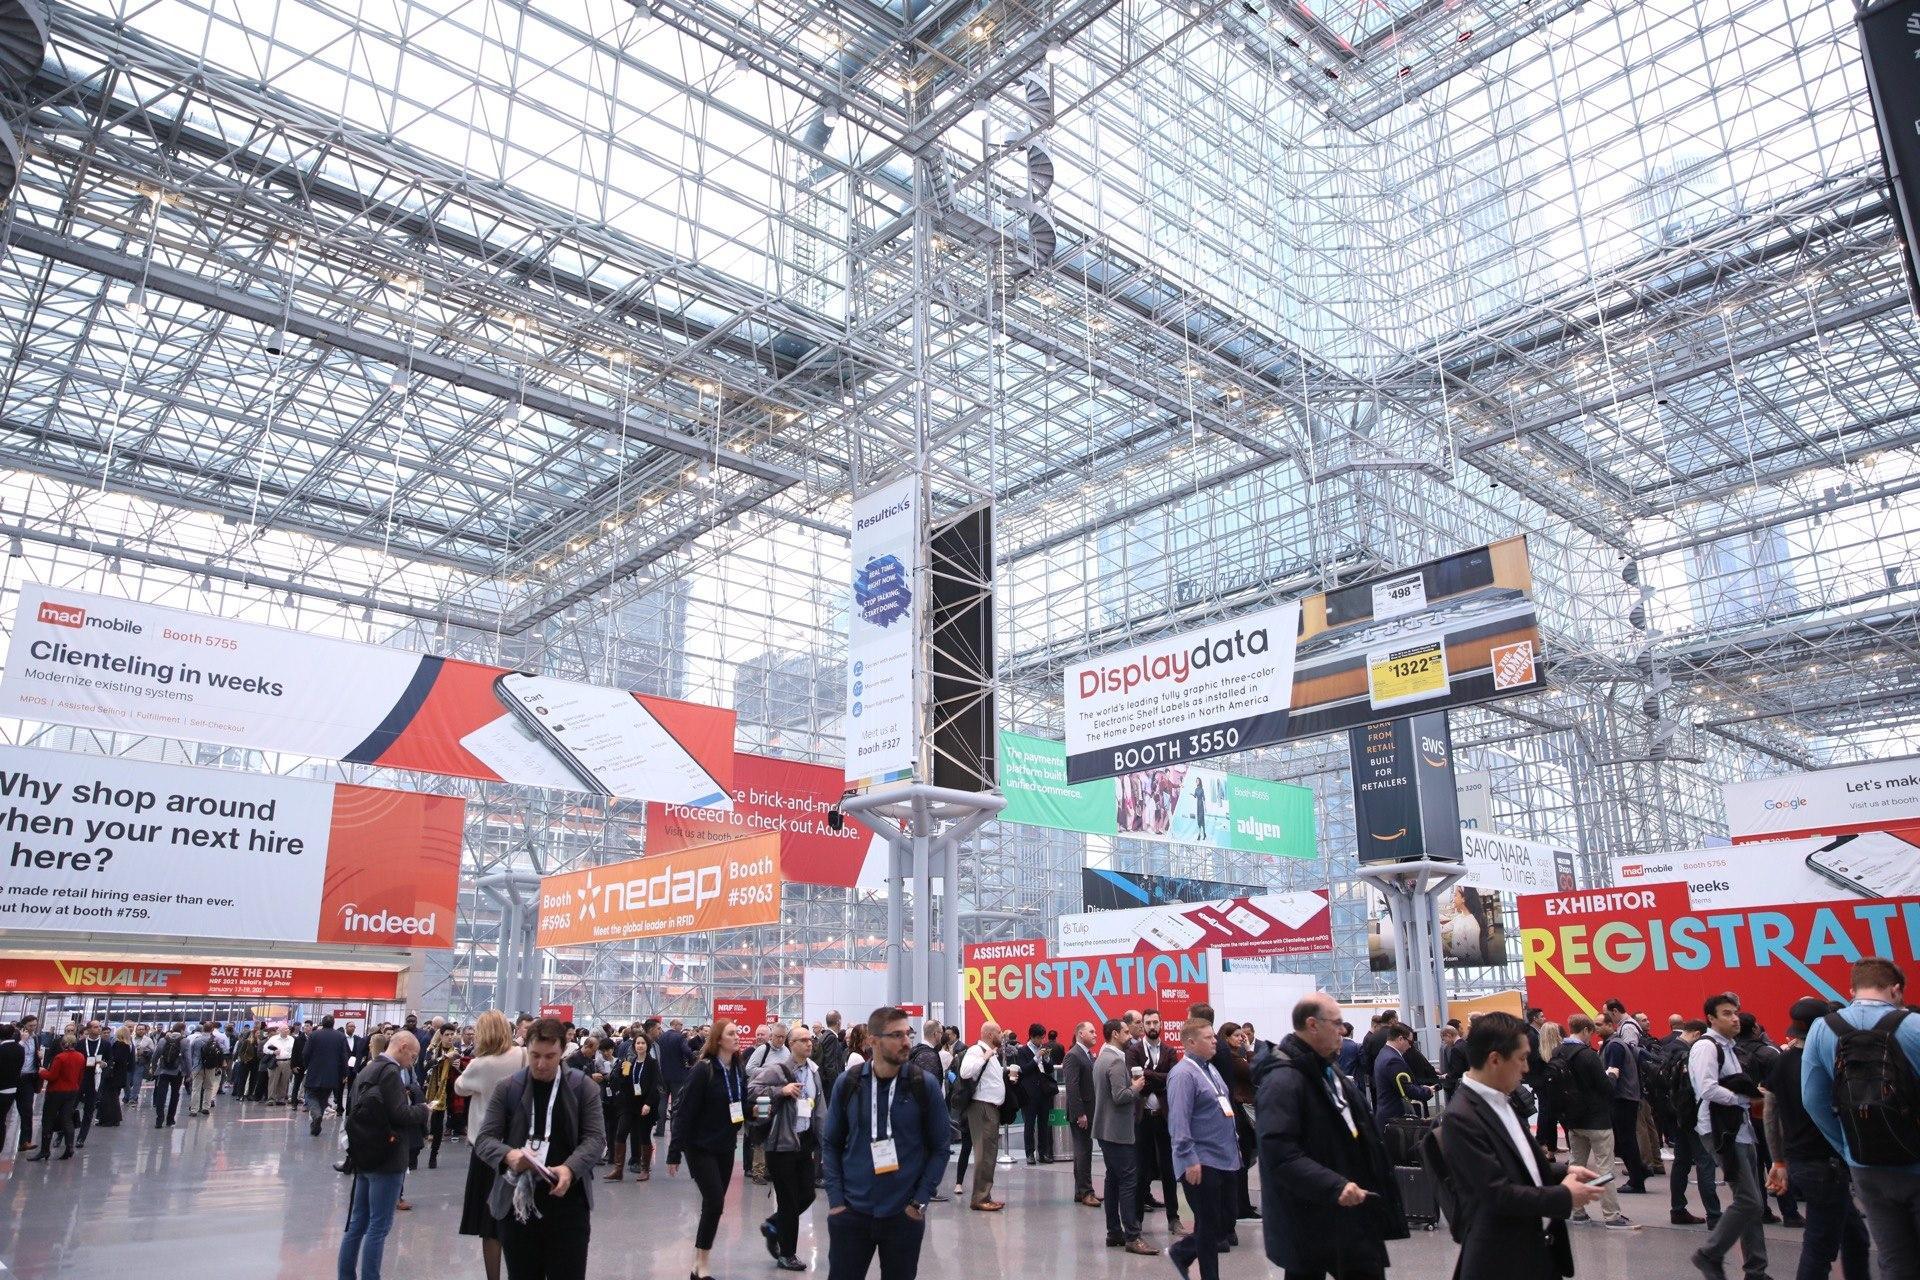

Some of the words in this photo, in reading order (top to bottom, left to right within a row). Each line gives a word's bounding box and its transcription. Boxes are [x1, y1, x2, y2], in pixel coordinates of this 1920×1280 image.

[857, 493, 910, 531] Resulticks
[864, 597, 876, 607] STOP
[1388, 587, 1410, 600] $498
[865, 607, 879, 618] START
[163, 628, 202, 645] Booth
[205, 635, 238, 650] 5755
[30, 640, 174, 683] Clienteling
[179, 663, 201, 684] in
[208, 672, 283, 697] weeks
[1080, 628, 1269, 699] Displaydata
[1389, 658, 1429, 678] $1322
[1497, 645, 1530, 686] HOME
[1498, 652, 1512, 667] THE
[1511, 658, 1532, 685] DEPOT
[25, 668, 92, 687] Modernize
[95, 678, 142, 697] existing
[145, 686, 194, 702] systems
[1080, 712, 1093, 721] The
[1096, 704, 1124, 716] world's
[1127, 697, 1159, 709] leading
[1162, 690, 1180, 700] fully
[1184, 682, 1218, 697] graphic
[1221, 668, 1275, 686] three-color
[20, 694, 47, 706] MPOS
[58, 700, 95, 712] Assisted
[98, 706, 126, 718] Selling
[136, 711, 180, 724] Fulfillment
[190, 718, 245, 732] Self-Checkout
[1094, 714, 1134, 729] Electronic
[1137, 706, 1158, 719] Shelf
[1161, 701, 1189, 714] Labels
[1193, 698, 1202, 706] as
[1206, 686, 1245, 703] installed
[1250, 684, 1258, 693] in
[890, 723, 897, 733] at
[1087, 734, 1100, 742] The
[1104, 728, 1127, 739] Home
[1130, 720, 1155, 732] Depot
[1159, 714, 1184, 726] stores
[1188, 711, 1196, 720] in
[1200, 705, 1225, 717] North
[1229, 695, 1269, 710] America
[1369, 731, 1392, 741] FROM
[1422, 736, 1445, 756] aws
[858, 742, 879, 756] Booth
[882, 738, 900, 750] #327
[1008, 746, 1022, 759] The
[1024, 753, 1064, 767] payments
[1114, 740, 1180, 770] BOOTH
[1190, 727, 1239, 753] 3550
[1366, 742, 1396, 754] RETAIL
[1370, 755, 1395, 766] BUILT
[1007, 764, 1042, 778] platform
[1044, 768, 1062, 779] built
[1376, 768, 1392, 777] FOR
[1007, 778, 1036, 791] unified
[1038, 785, 1082, 799] commerce.
[1362, 777, 1407, 791] RETAILERS
[1846, 780, 1882, 793] Let's
[1886, 775, 1920, 788] mak
[72, 780, 156, 814] shop
[166, 794, 276, 822] around
[1765, 797, 1807, 810] Google
[1892, 796, 1918, 805] booth
[665, 803, 724, 823] Proceed
[729, 812, 743, 825] to
[748, 811, 787, 832] check
[791, 820, 812, 834] out
[1237, 816, 1280, 841] adyen
[84, 818, 162, 843] your
[171, 825, 240, 850] next
[249, 828, 304, 855] hire
[665, 826, 683, 837] Visit
[685, 830, 695, 838] us
[708, 830, 731, 841] booth
[10, 842, 113, 872] here?
[1465, 836, 1532, 867] SAYONARA
[729, 856, 773, 879] Booth
[1501, 863, 1512, 882] to
[1684, 862, 1705, 870] Booth
[8, 886, 48, 896] made
[52, 888, 88, 898] retail
[91, 889, 129, 903] hiring
[132, 892, 172, 904] easier
[176, 894, 203, 906] than
[206, 898, 235, 907] ever.
[604, 864, 722, 913] nedap
[728, 884, 773, 906] #5963
[544, 892, 572, 908] Booth
[1545, 891, 1656, 916] EXHIBITOR
[20, 903, 52, 914] how
[55, 905, 70, 915] at
[73, 906, 113, 917] booth
[117, 908, 150, 919] #759.
[342, 906, 436, 936] indeed
[542, 914, 570, 930] #5963
[594, 924, 610, 936] Meet
[611, 923, 621, 935] the
[622, 920, 642, 935] global
[644, 919, 666, 932] leader
[668, 917, 675, 928] in
[676, 914, 694, 927] RFID
[1073, 922, 1089, 935] Tulip
[974, 944, 1035, 960] ASSISTANCE
[1093, 938, 1117, 946] connected
[54, 960, 181, 987] VISUALIZE
[210, 967, 239, 977] SAVE
[242, 968, 263, 978] THE
[266, 969, 293, 979] DATE
[964, 952, 1209, 1022] REGISTRATION
[1162, 988, 1176, 999] NRF
